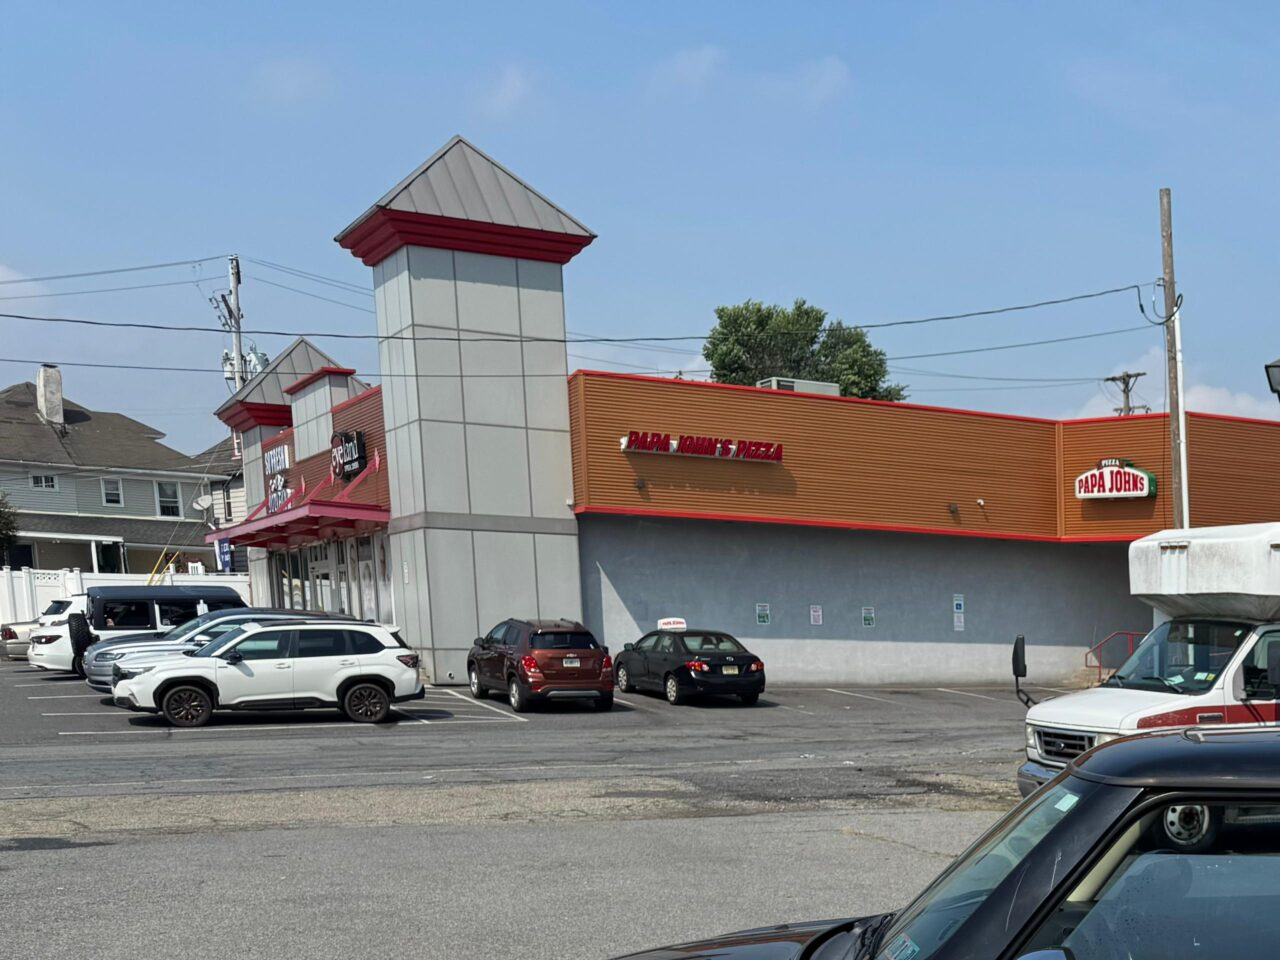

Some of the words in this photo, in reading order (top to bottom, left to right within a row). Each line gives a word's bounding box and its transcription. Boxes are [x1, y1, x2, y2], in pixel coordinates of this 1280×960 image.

[331, 431, 359, 473] eyeland
[627, 431, 671, 451] PAPA
[677, 435, 733, 457] JOHN'S
[735, 440, 784, 462] PIZZA
[1078, 471, 1106, 494] PAPA
[1109, 470, 1145, 493] JOHNS
